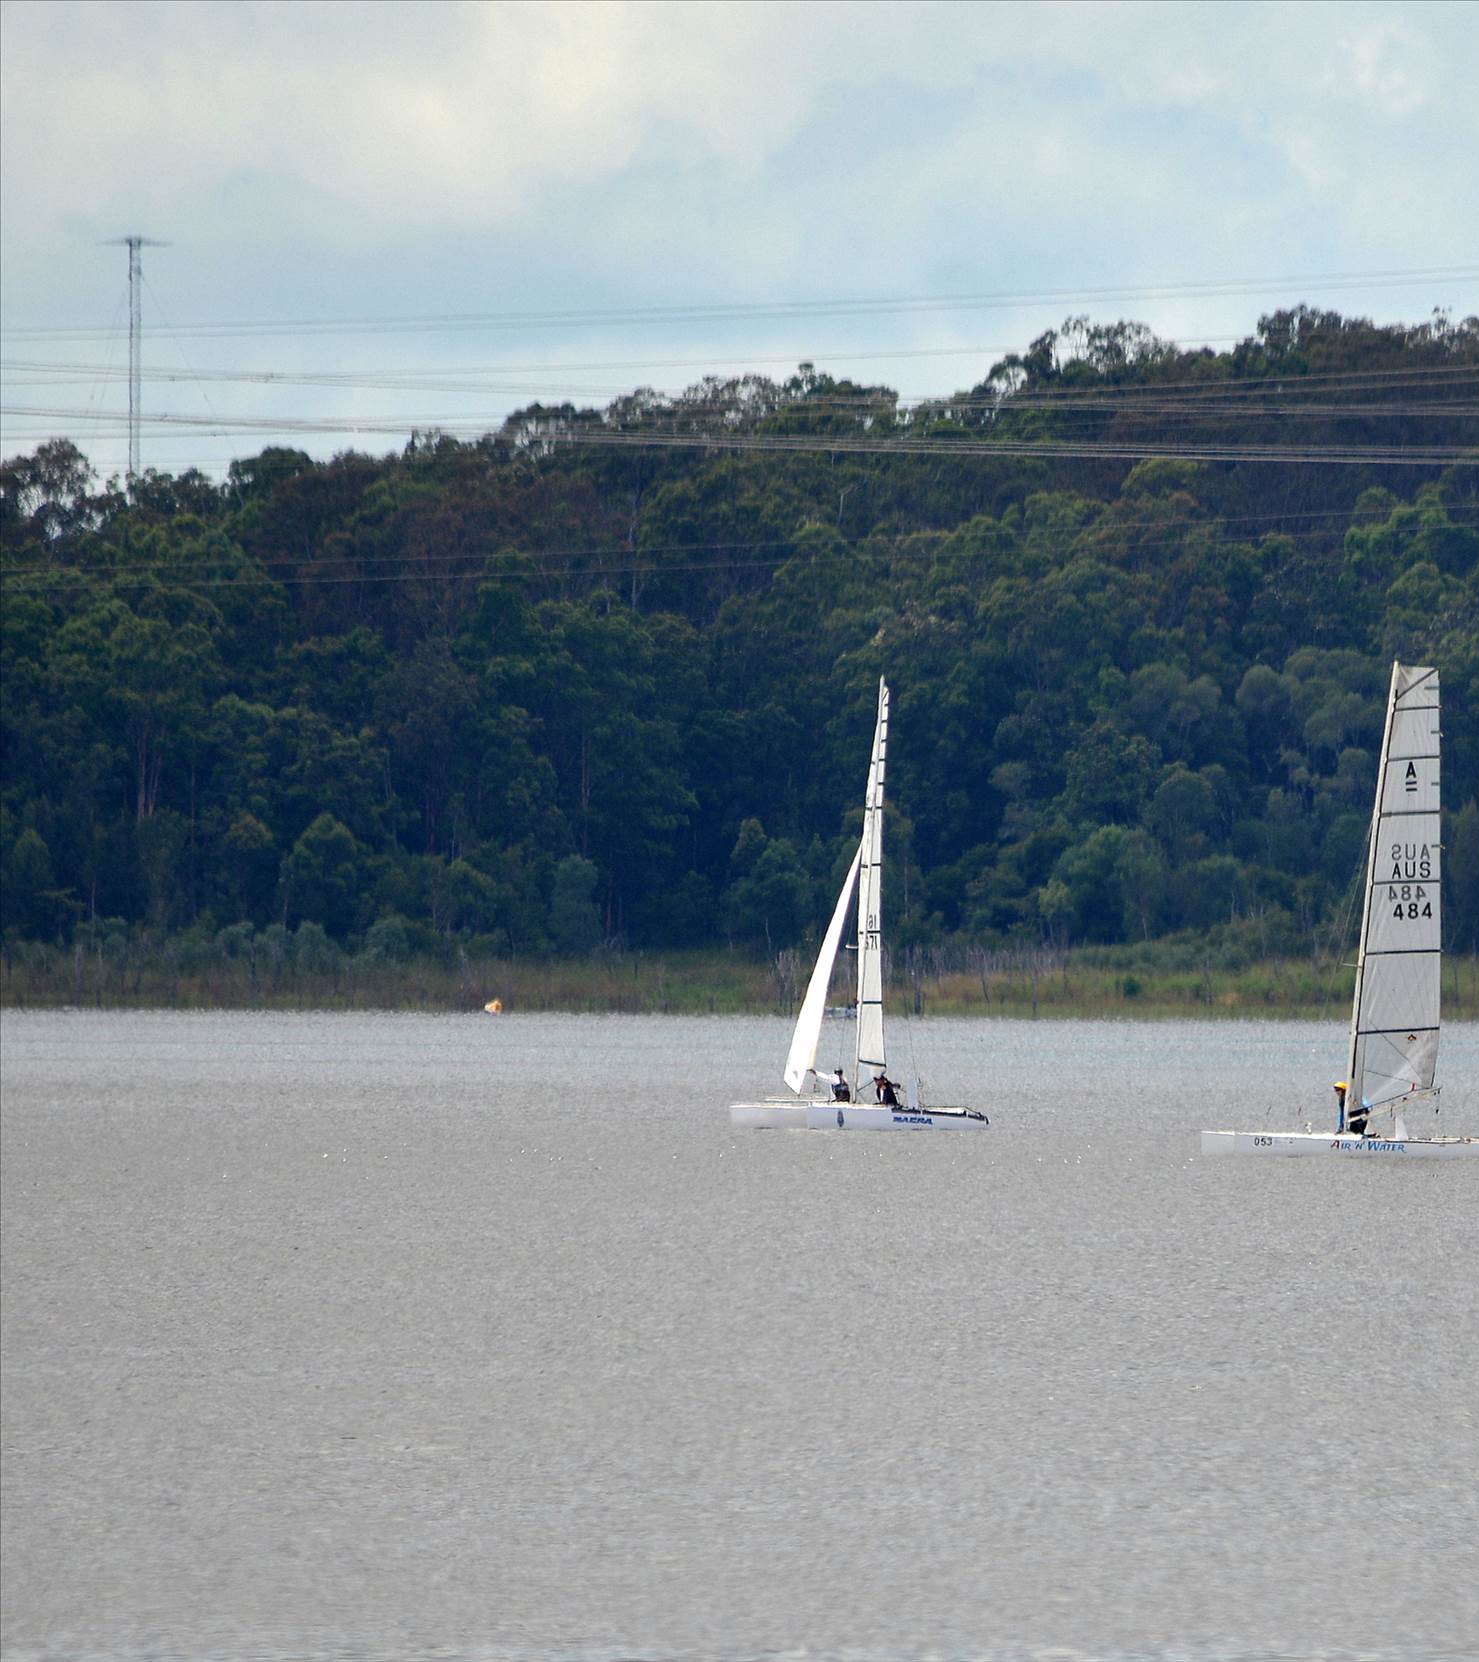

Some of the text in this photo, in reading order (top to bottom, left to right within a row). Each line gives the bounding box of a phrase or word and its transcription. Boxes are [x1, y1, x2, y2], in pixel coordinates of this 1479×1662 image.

[1405, 761, 1417, 778] A
[1392, 861, 1431, 879] AUS
[1393, 902, 1432, 920] 484
[1254, 1137, 1273, 1146] 053
